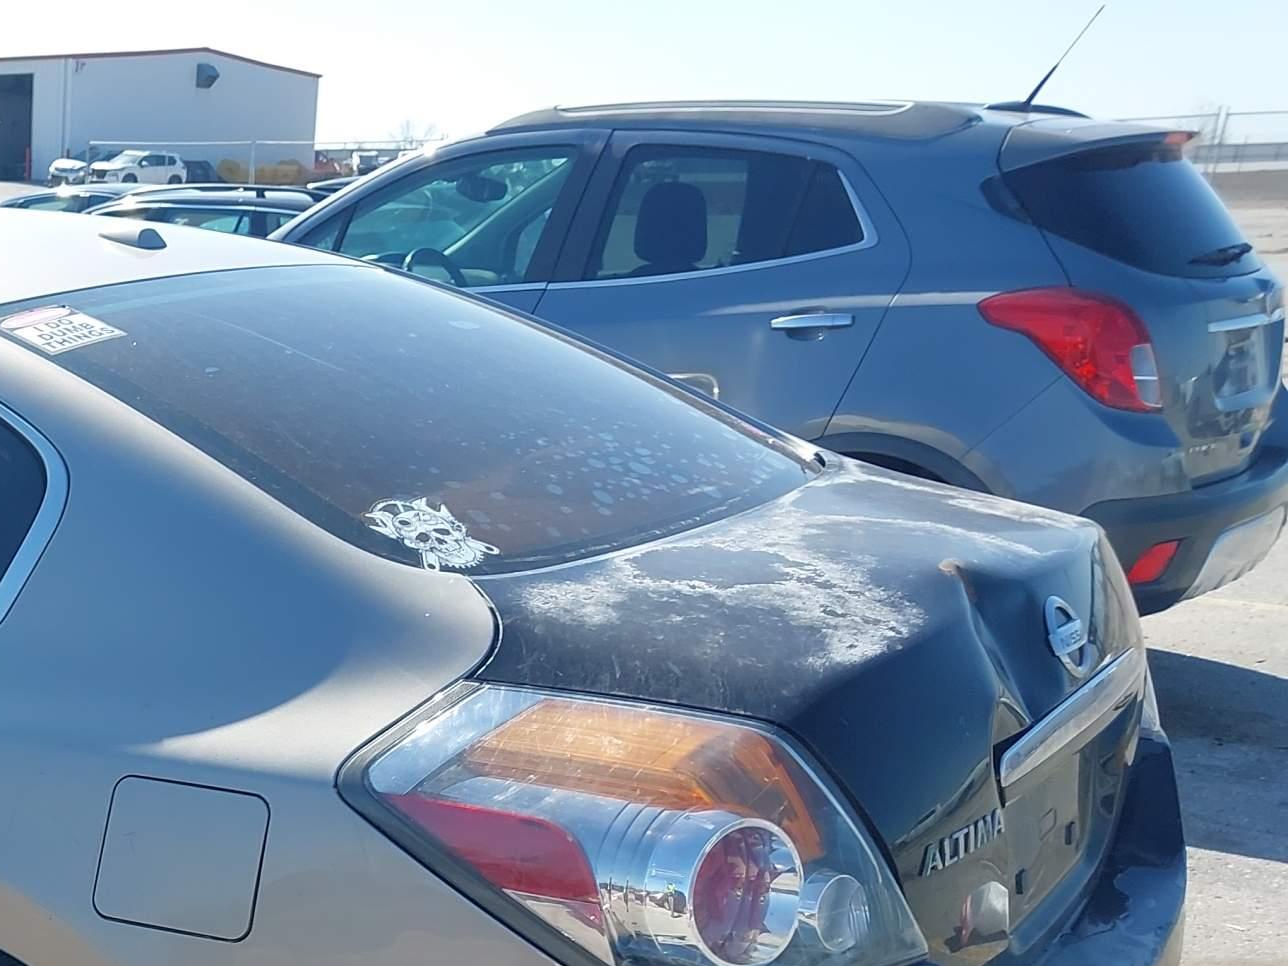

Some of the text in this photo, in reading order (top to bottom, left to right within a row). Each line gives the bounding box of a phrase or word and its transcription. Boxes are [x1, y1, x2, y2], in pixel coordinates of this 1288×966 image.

[38, 323, 95, 341] DUMB
[45, 318, 73, 330] DO
[41, 327, 115, 350] THINGS
[921, 808, 1005, 877] ALTIMA
